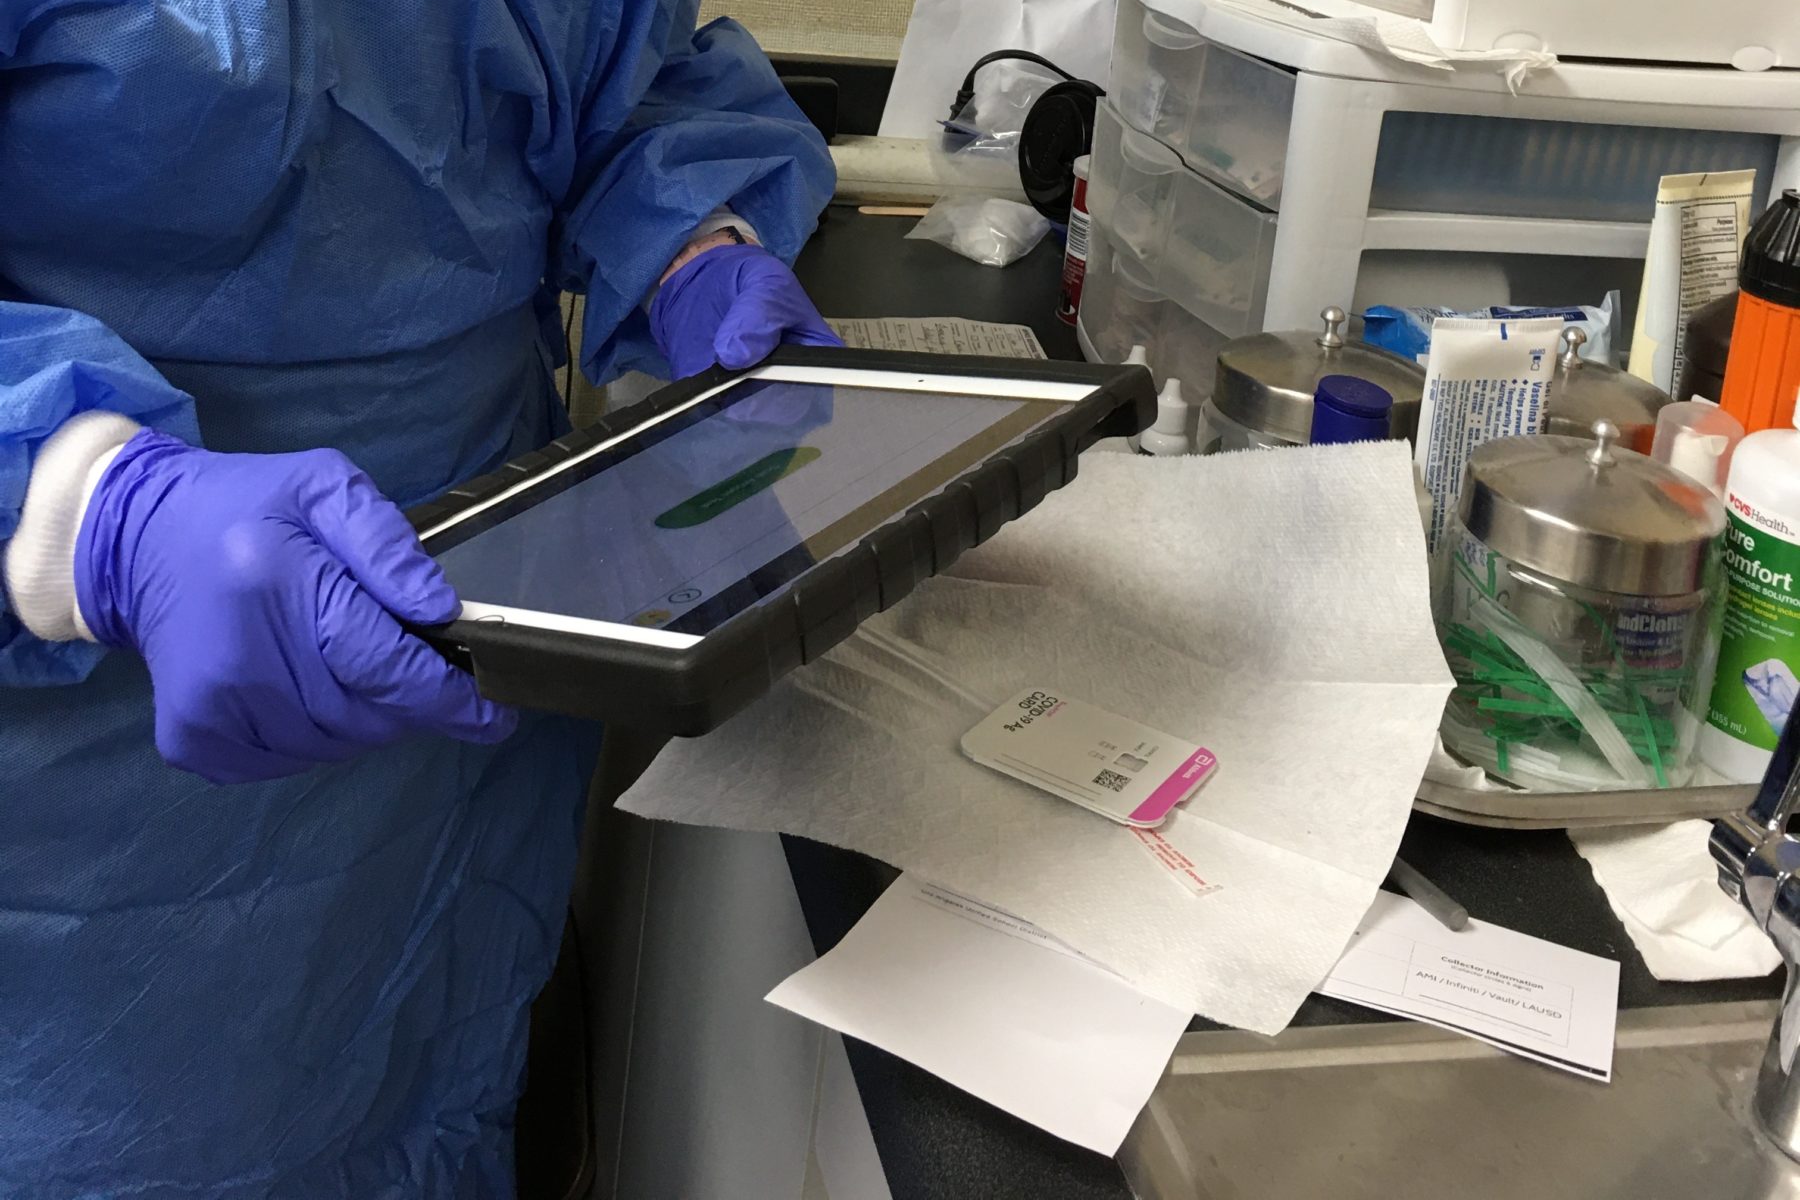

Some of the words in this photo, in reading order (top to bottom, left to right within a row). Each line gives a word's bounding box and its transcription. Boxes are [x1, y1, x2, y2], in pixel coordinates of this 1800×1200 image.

[1502, 387, 1516, 428] Temporarily
[1516, 388, 1527, 407] Helps
[1528, 381, 1542, 422] Vaselina
[1726, 549, 1793, 591] omfort
[1762, 587, 1800, 607] SOLUTIO
[1019, 692, 1045, 708] CARD
[1020, 697, 1058, 724] COVID-19
[1004, 722, 1024, 732] Ag
[1730, 721, 1747, 736] mL)
[1441, 956, 1484, 973] Collector
[1486, 968, 1544, 990] Information
[1522, 1001, 1563, 1019] LAUSD
